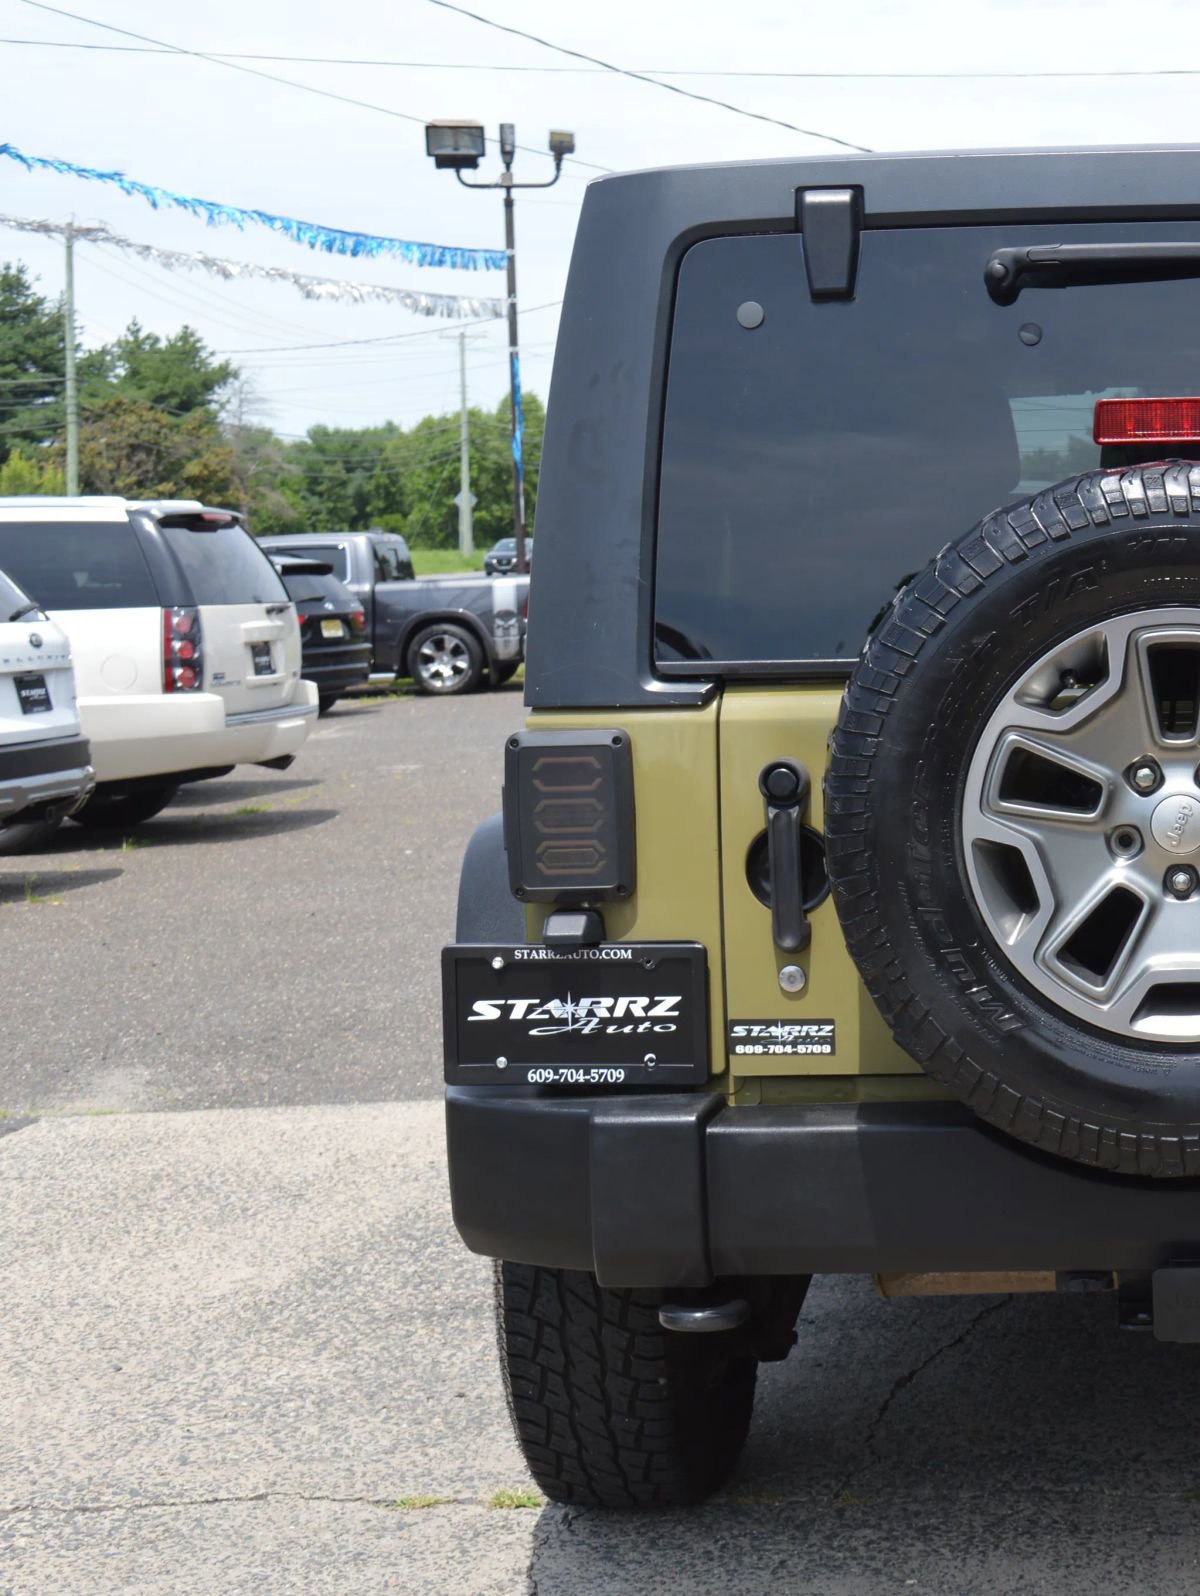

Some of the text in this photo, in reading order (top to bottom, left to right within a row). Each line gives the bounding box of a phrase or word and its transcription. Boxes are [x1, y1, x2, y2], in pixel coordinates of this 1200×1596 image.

[1165, 802, 1194, 848] Jeep
[467, 995, 682, 1021] STARRZ
[528, 1016, 677, 1036] Auto
[731, 1025, 834, 1037] STARRZ
[735, 1044, 832, 1055] 609-704-5709
[527, 1068, 626, 1084] 609-704-5709
